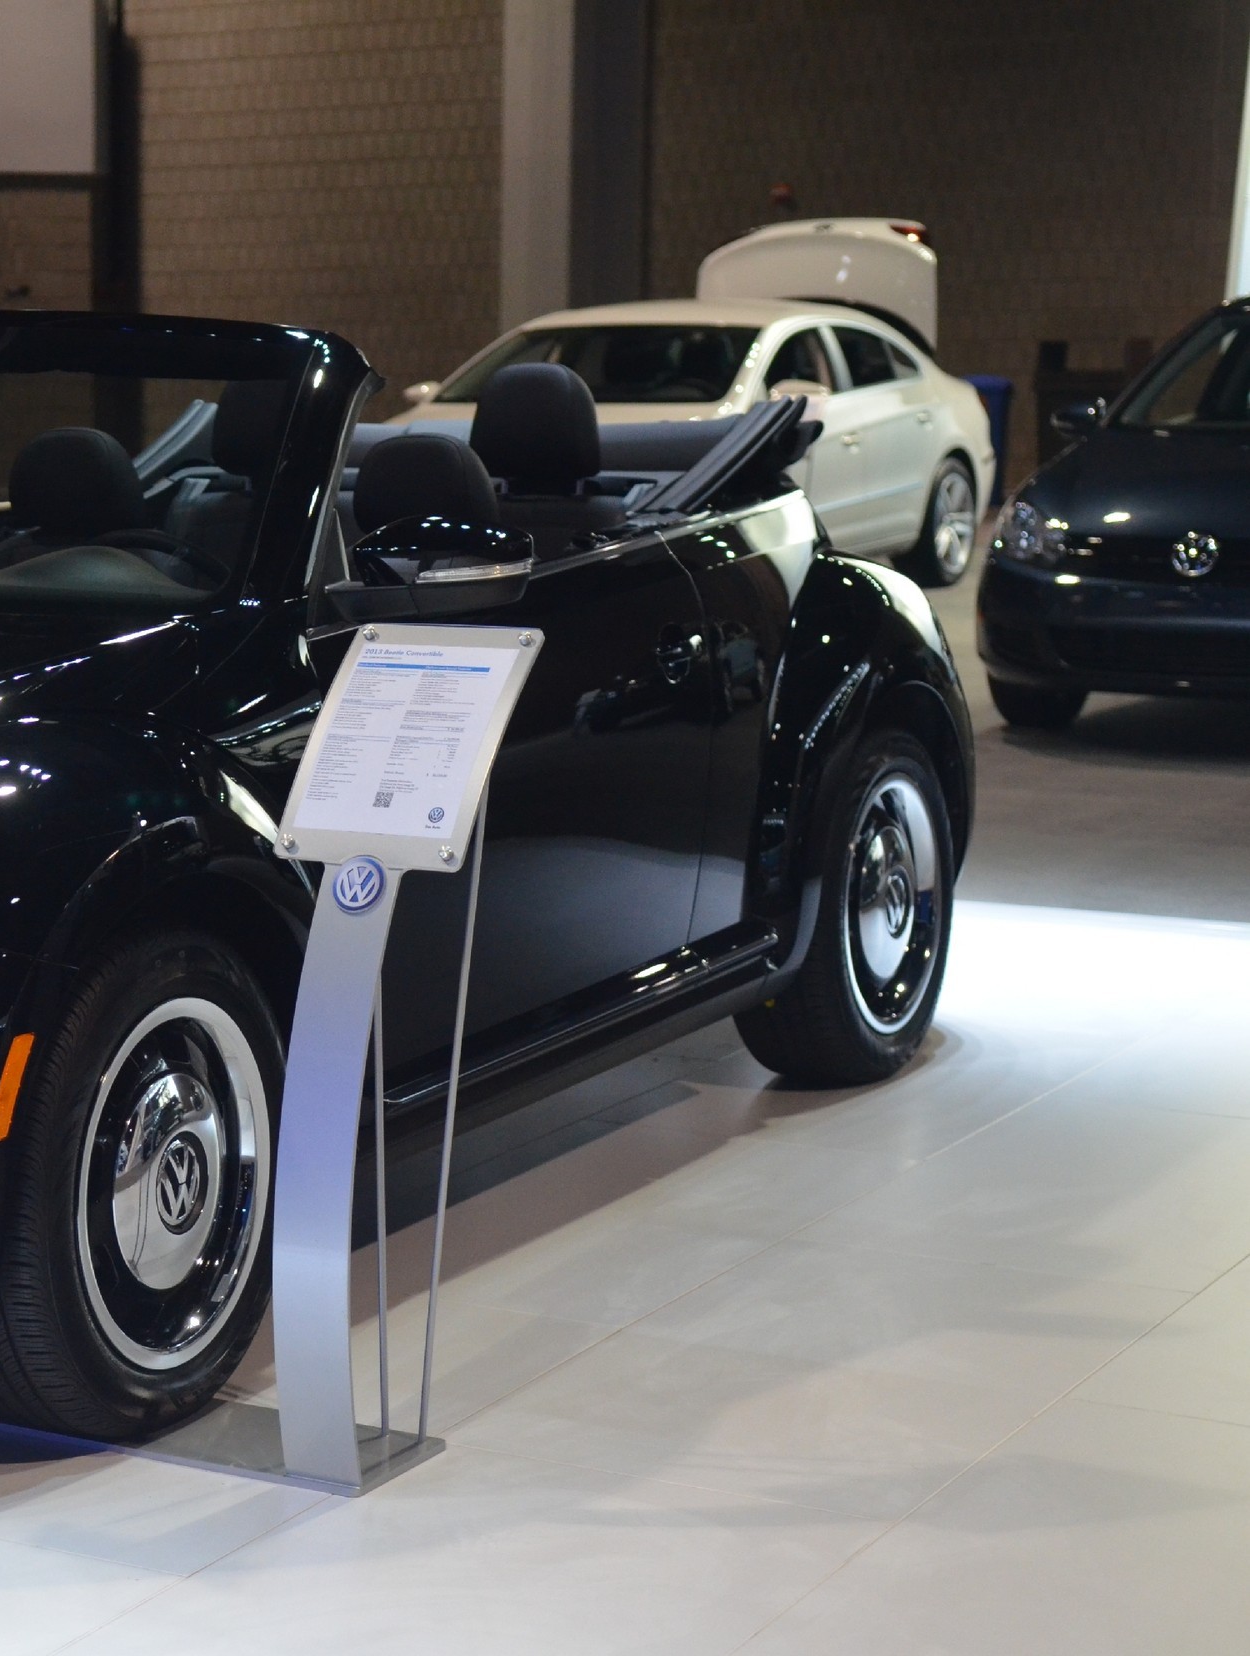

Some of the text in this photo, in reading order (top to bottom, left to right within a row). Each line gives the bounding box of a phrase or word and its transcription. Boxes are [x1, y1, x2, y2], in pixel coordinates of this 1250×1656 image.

[365, 648, 383, 656] 2013
[335, 858, 382, 909] VW
[156, 1140, 200, 1226] VW
